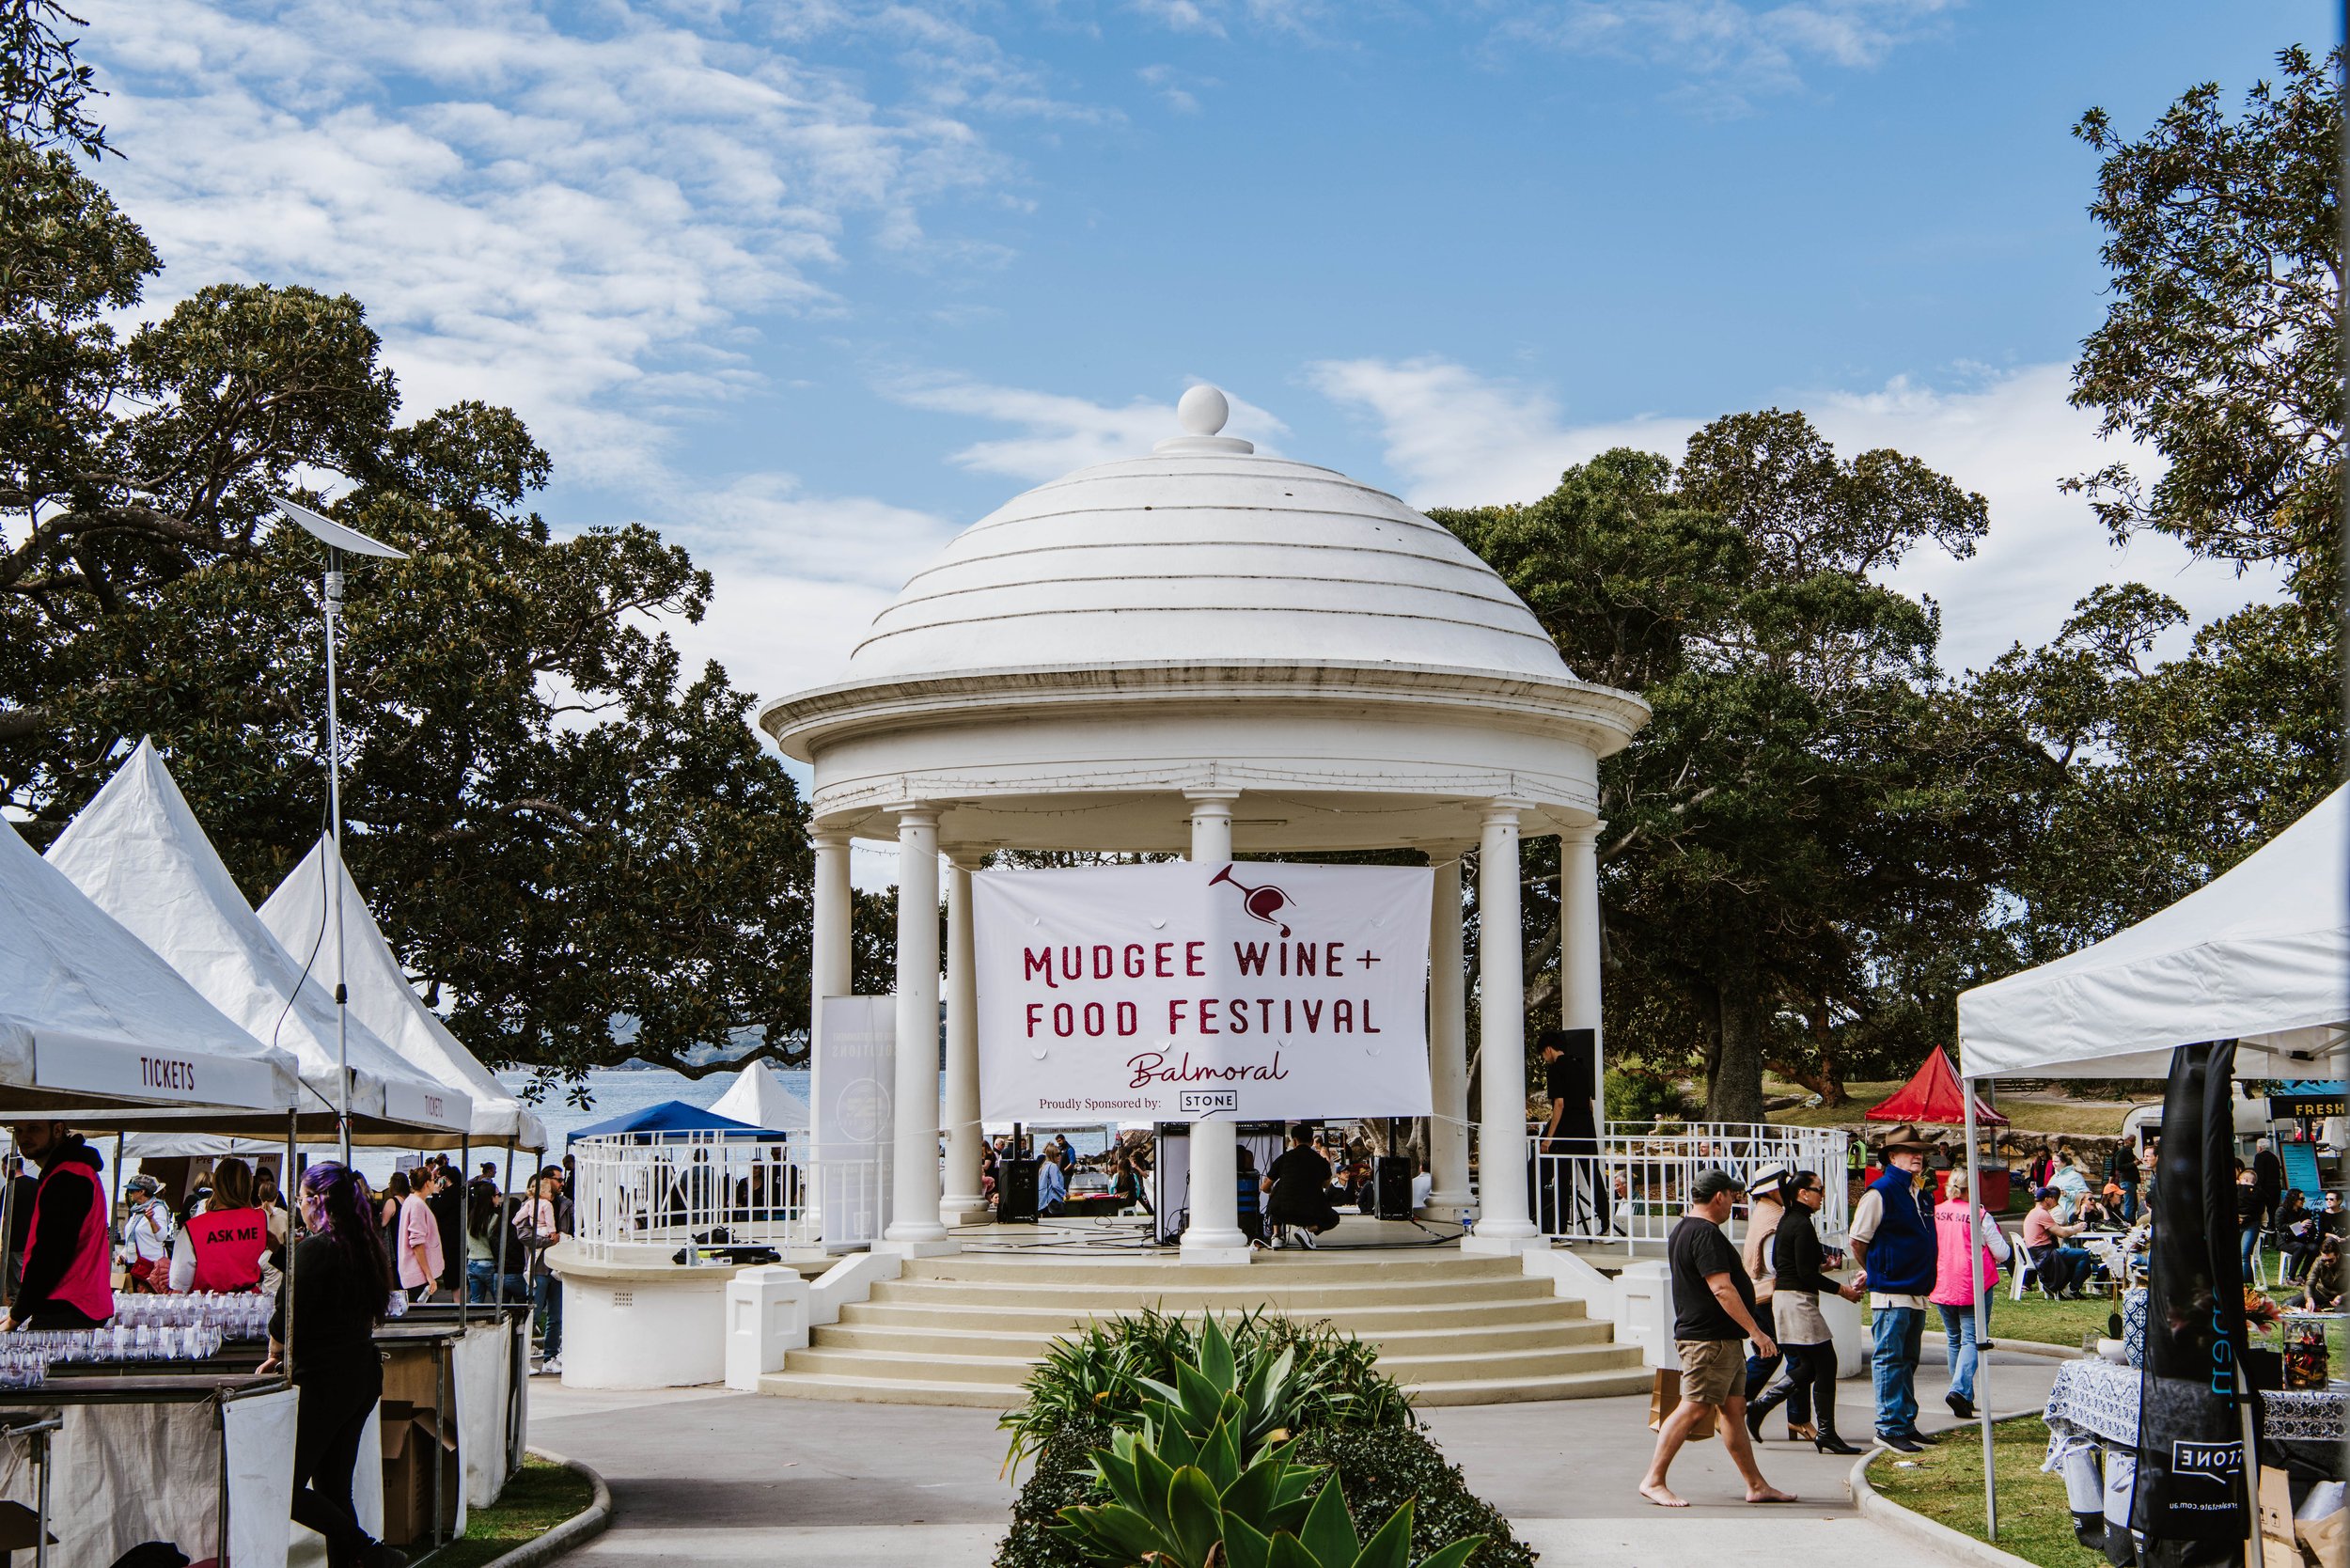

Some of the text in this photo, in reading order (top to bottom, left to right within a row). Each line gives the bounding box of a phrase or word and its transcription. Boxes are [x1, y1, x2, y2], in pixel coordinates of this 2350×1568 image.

[1024, 941, 1206, 988] MUDGEE
[1026, 998, 1381, 1038] FOOD FESTIVAL
[141, 1057, 195, 1090] TICKETS
[1127, 1051, 1289, 1089] Balmoral
[425, 1095, 443, 1118] TICKETS
[1040, 1098, 1161, 1110] Proudly Sponsored by:
[1185, 1095, 1233, 1106] STONE
[2295, 1103, 2345, 1116] FRESH
[1935, 1212, 1970, 1224] ASK ME
[207, 1227, 258, 1244] ASK ME
